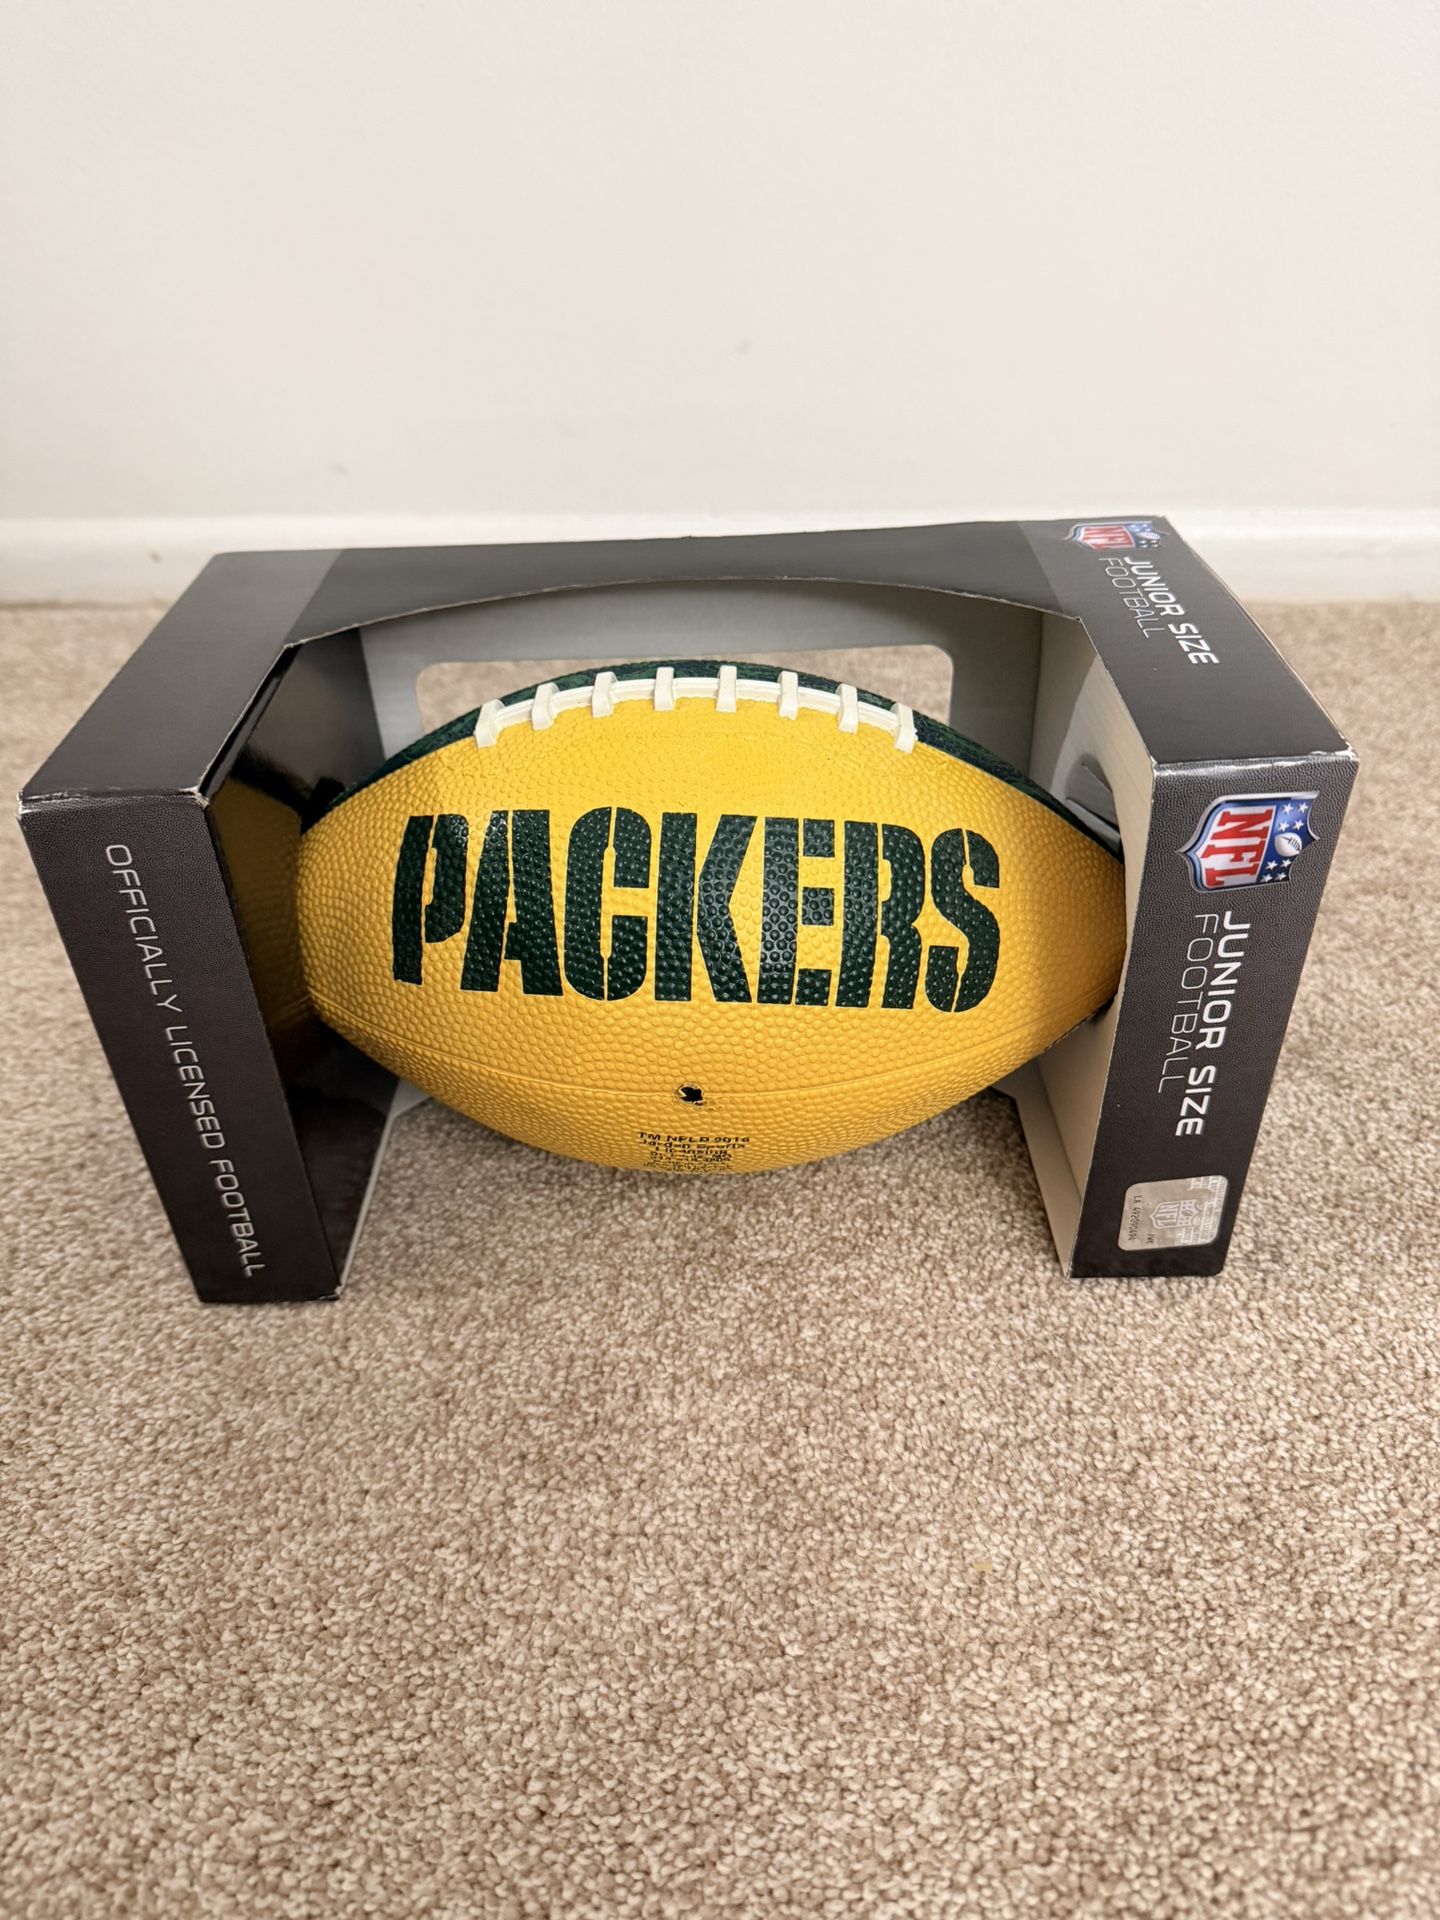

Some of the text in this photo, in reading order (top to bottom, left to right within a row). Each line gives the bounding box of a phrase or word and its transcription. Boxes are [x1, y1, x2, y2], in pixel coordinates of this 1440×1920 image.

[1099, 557, 1166, 638] FOOTBALL
[1123, 556, 1220, 664] JUNIOR SIZE
[1198, 808, 1275, 888] NFL
[392, 806, 1001, 1013] PACKERS
[1158, 912, 1220, 1094] FOOTBALL
[1194, 910, 1252, 1050] JUNIOR
[105, 843, 266, 1278] OFFICIALLY LICENSED FOOTBALL
[1175, 1064, 1218, 1137] SIZE
[637, 1131, 661, 1141] TM
